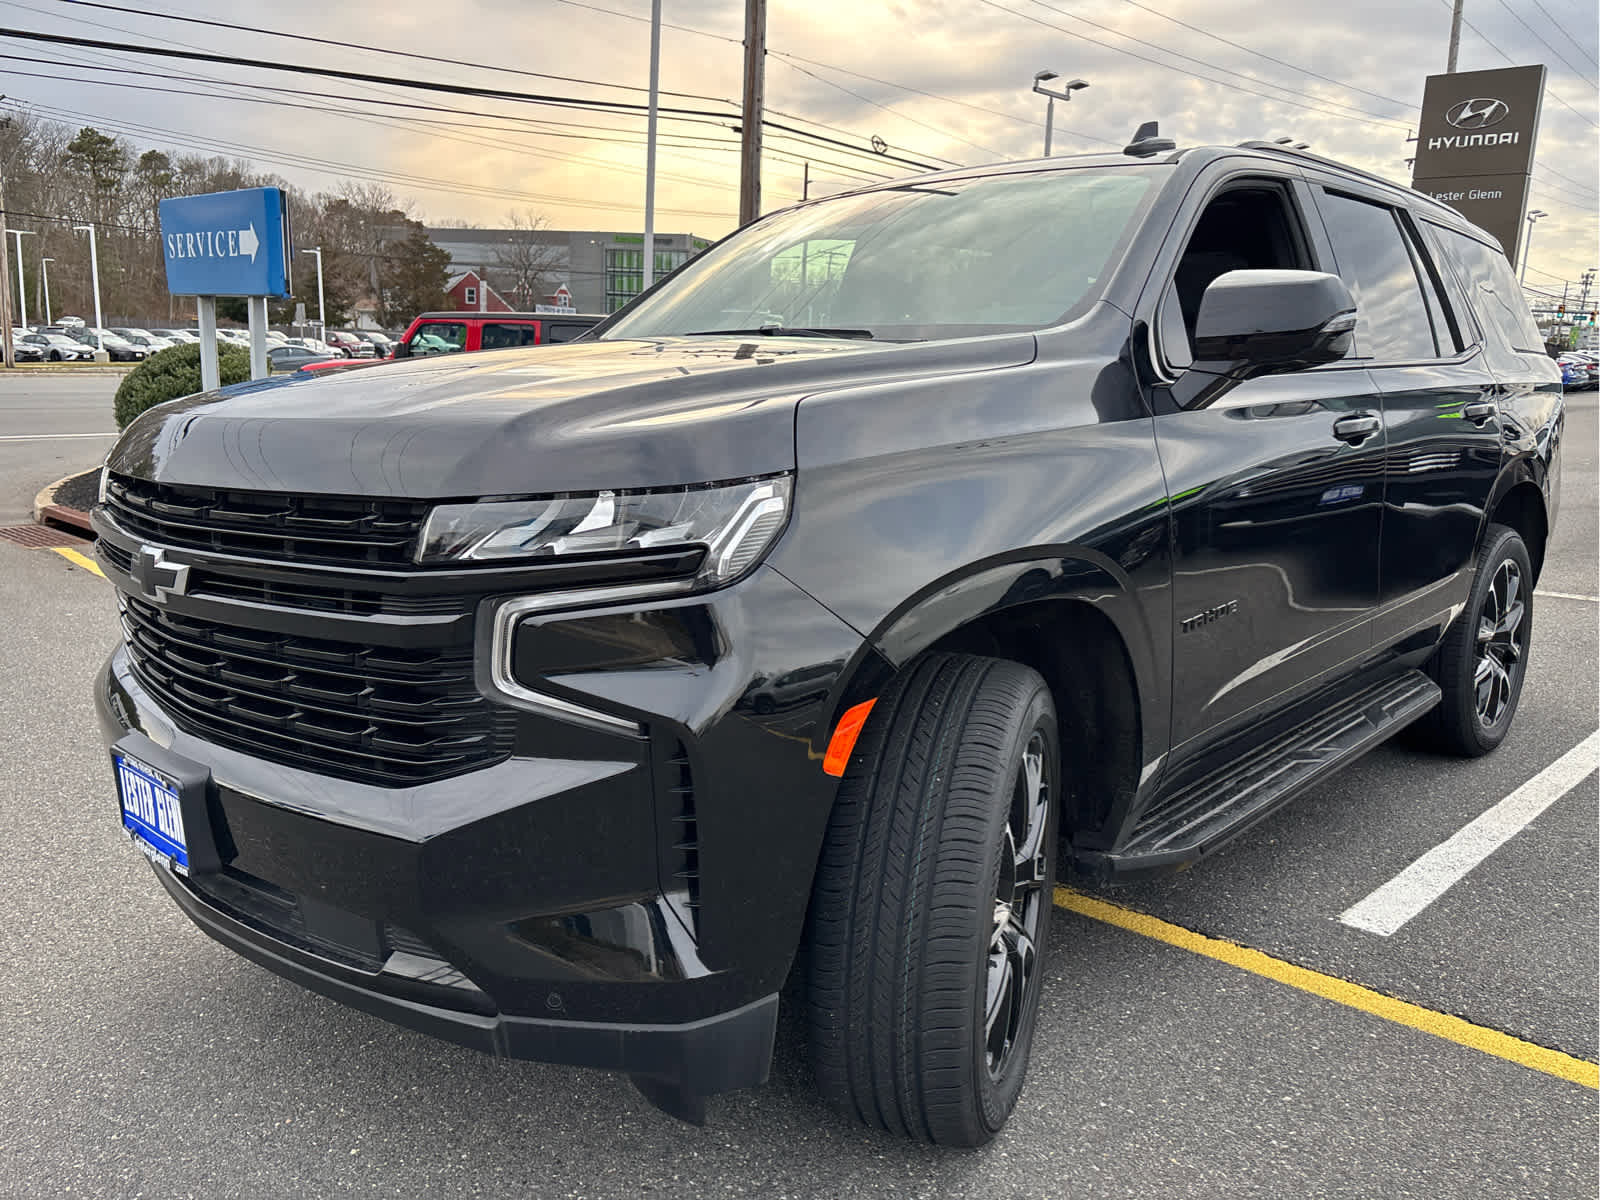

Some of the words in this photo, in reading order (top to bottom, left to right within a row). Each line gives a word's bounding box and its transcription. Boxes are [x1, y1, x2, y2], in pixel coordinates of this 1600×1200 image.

[1428, 132, 1519, 150] HYUNDAI
[1430, 191, 1465, 201] Lester
[1469, 190, 1502, 200] Glenn
[168, 230, 239, 258] SERVICE
[119, 766, 156, 827] LESTER
